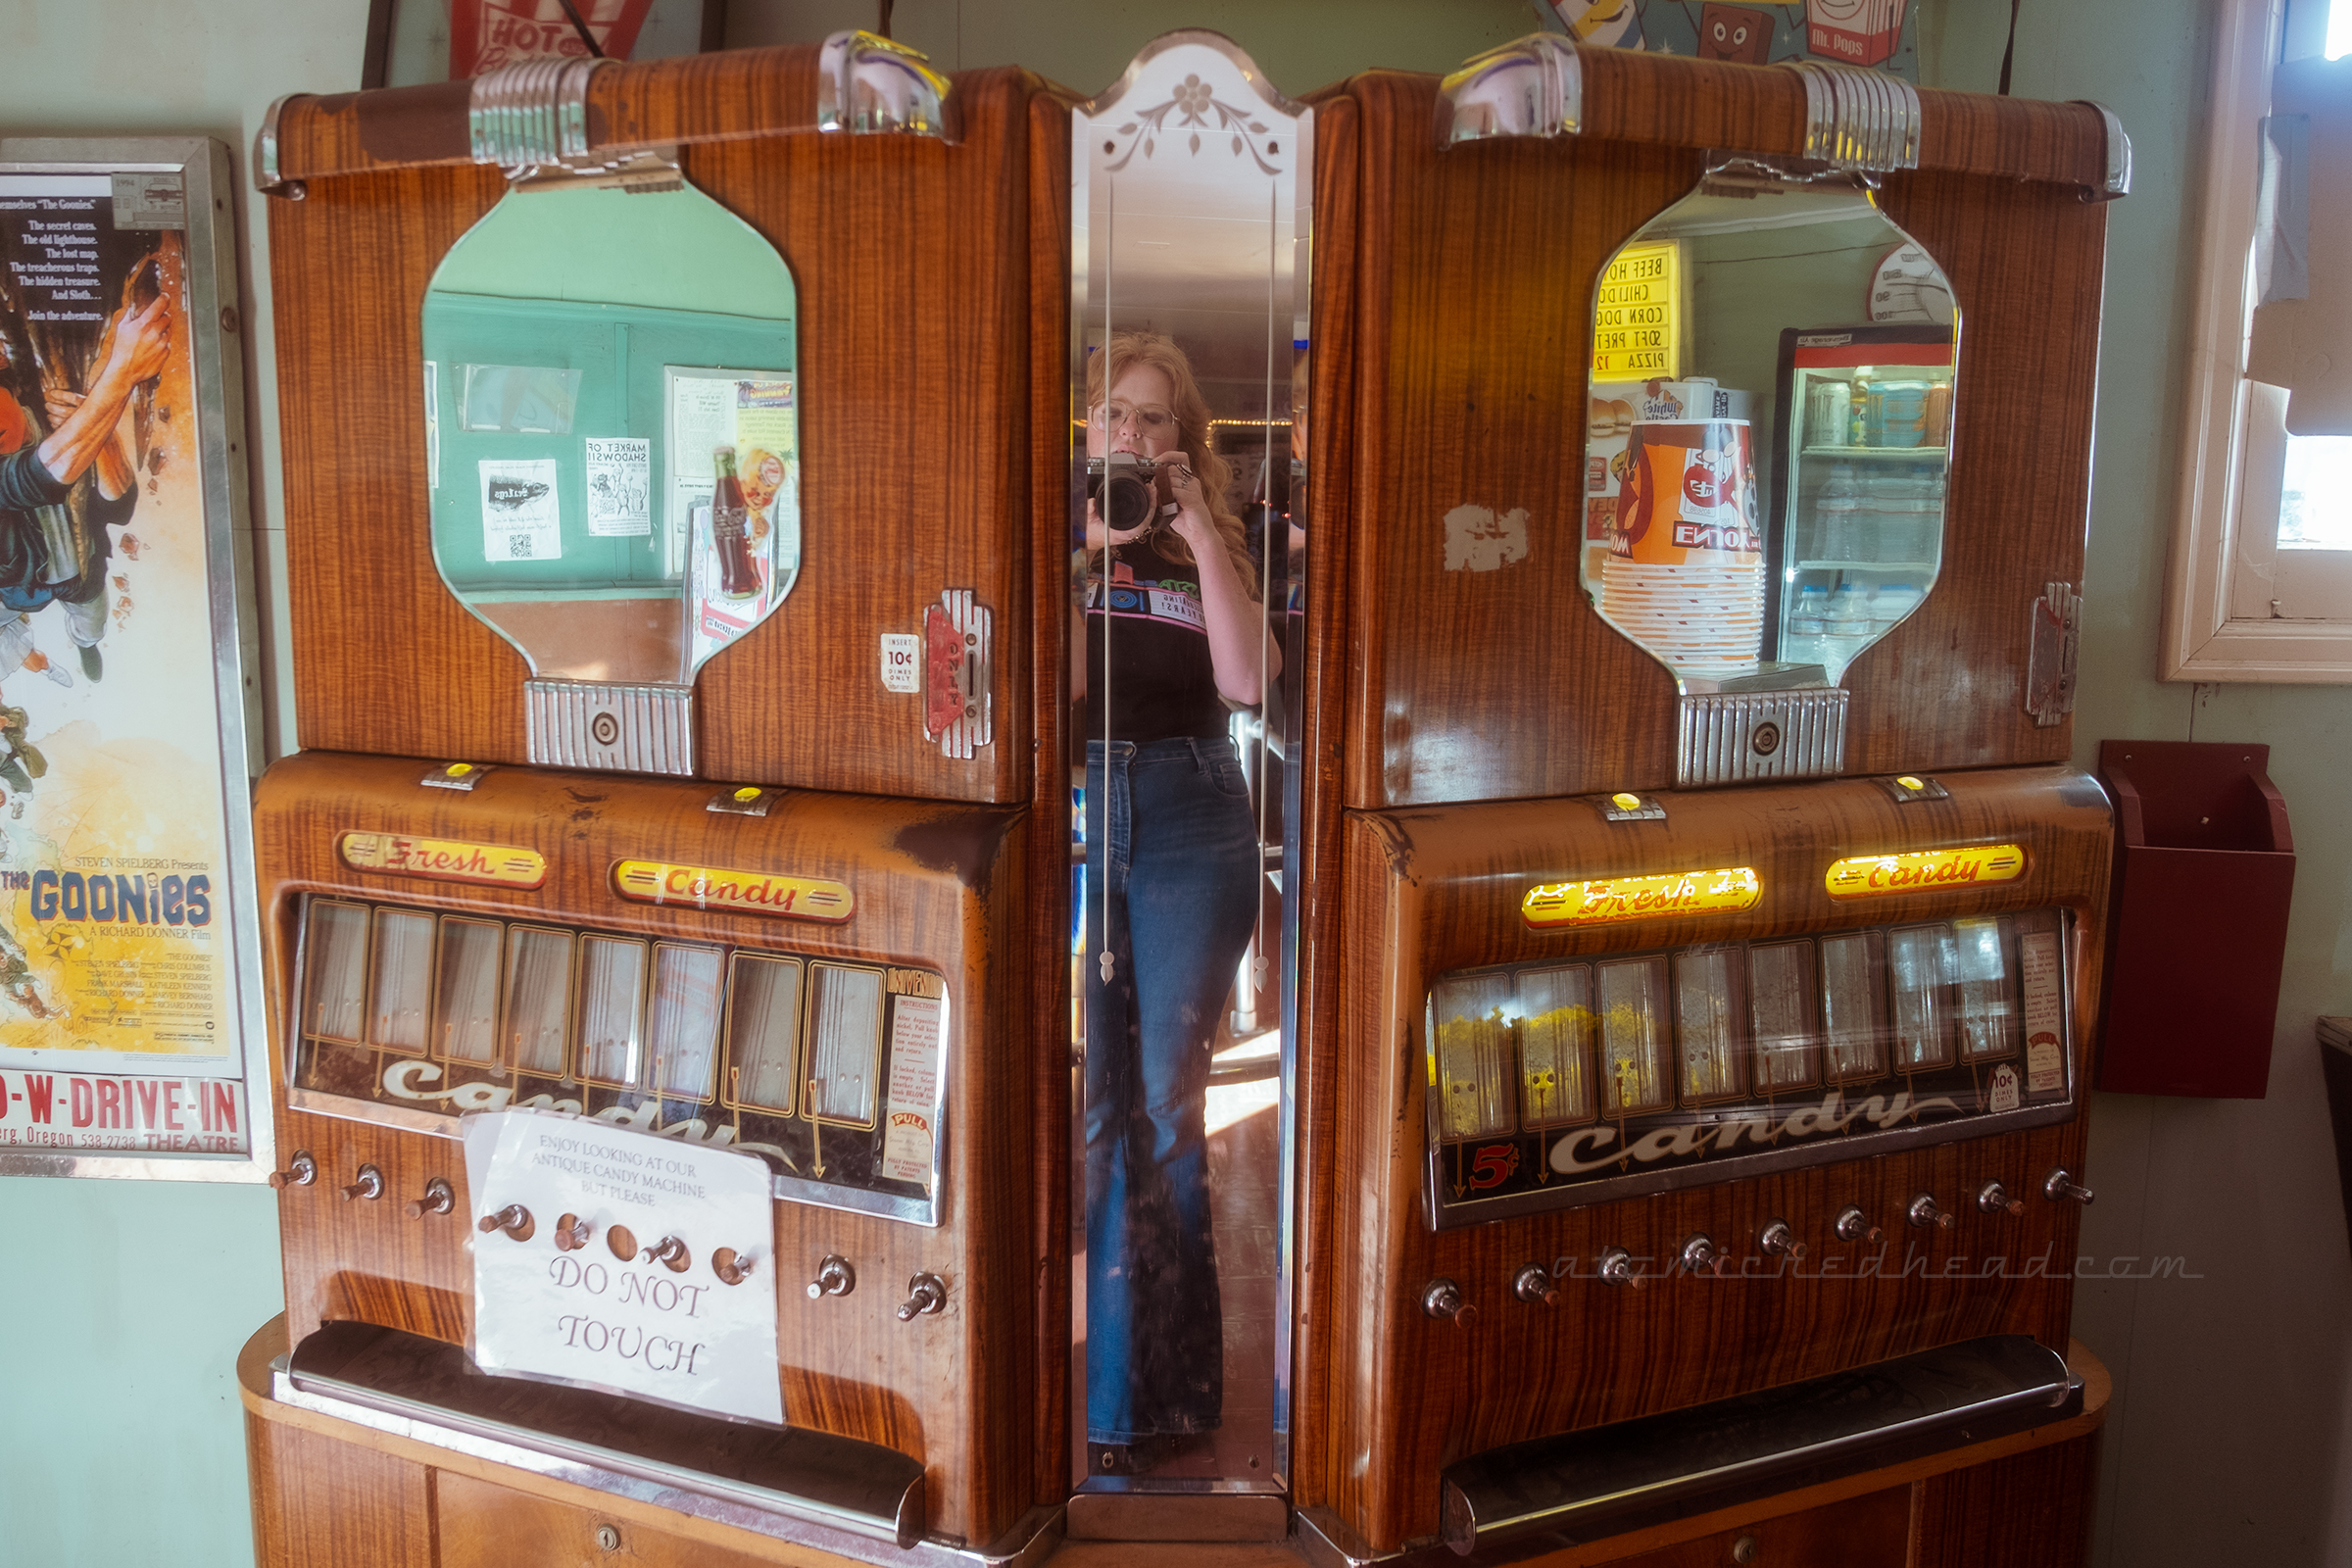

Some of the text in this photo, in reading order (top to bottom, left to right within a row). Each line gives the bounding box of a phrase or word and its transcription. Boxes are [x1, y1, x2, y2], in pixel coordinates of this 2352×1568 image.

[492, 18, 563, 53] HOT
[1812, 28, 1863, 57] Mr. Pops
[27, 220, 45, 230] The
[46, 221, 72, 231] secret
[22, 234, 38, 245] The
[39, 234, 53, 245] old
[45, 248, 62, 259] The
[63, 248, 78, 259] lost
[10, 262, 26, 272] The
[26, 262, 75, 272] treacherous
[18, 275, 34, 286] The
[35, 275, 64, 286] hidden
[52, 289, 69, 300] And
[27, 310, 45, 320] Join
[46, 310, 60, 320] the
[888, 651, 912, 666] 10¢
[75, 857, 209, 871] STEVEN SPIELBERG Presents
[388, 841, 495, 875] Fresh
[1868, 855, 1982, 889] Candy
[665, 868, 797, 911] Candy
[1578, 878, 1701, 915] Fresh
[90, 926, 212, 941] A RICHARD DONNER Film
[179, 973, 212, 982] SPIELBERG
[187, 1002, 213, 1010] DONNER
[900, 1000, 938, 1011] INSTRUCTIONS
[2032, 1034, 2054, 1045] PULL
[1995, 1074, 2013, 1089] 10¢
[1995, 1089, 2013, 1098] DIMES
[895, 1113, 924, 1129] PULL
[27, 1126, 74, 1149] Oregon
[81, 1134, 135, 1151] 538-2738
[1548, 1092, 1964, 1175] Candy
[143, 1134, 239, 1153] THEATRE
[540, 1134, 697, 1178] ENJOY LOOKING AT OUR
[903, 1160, 927, 1169] PROTECTED
[1469, 1142, 1520, 1190] 5¢
[532, 1152, 706, 1199] ANTIQUE CANDY MACHINE
[581, 1180, 656, 1206] BUT PLEASE
[549, 1255, 710, 1318] DO NOT
[558, 1314, 706, 1376] TOUCH
